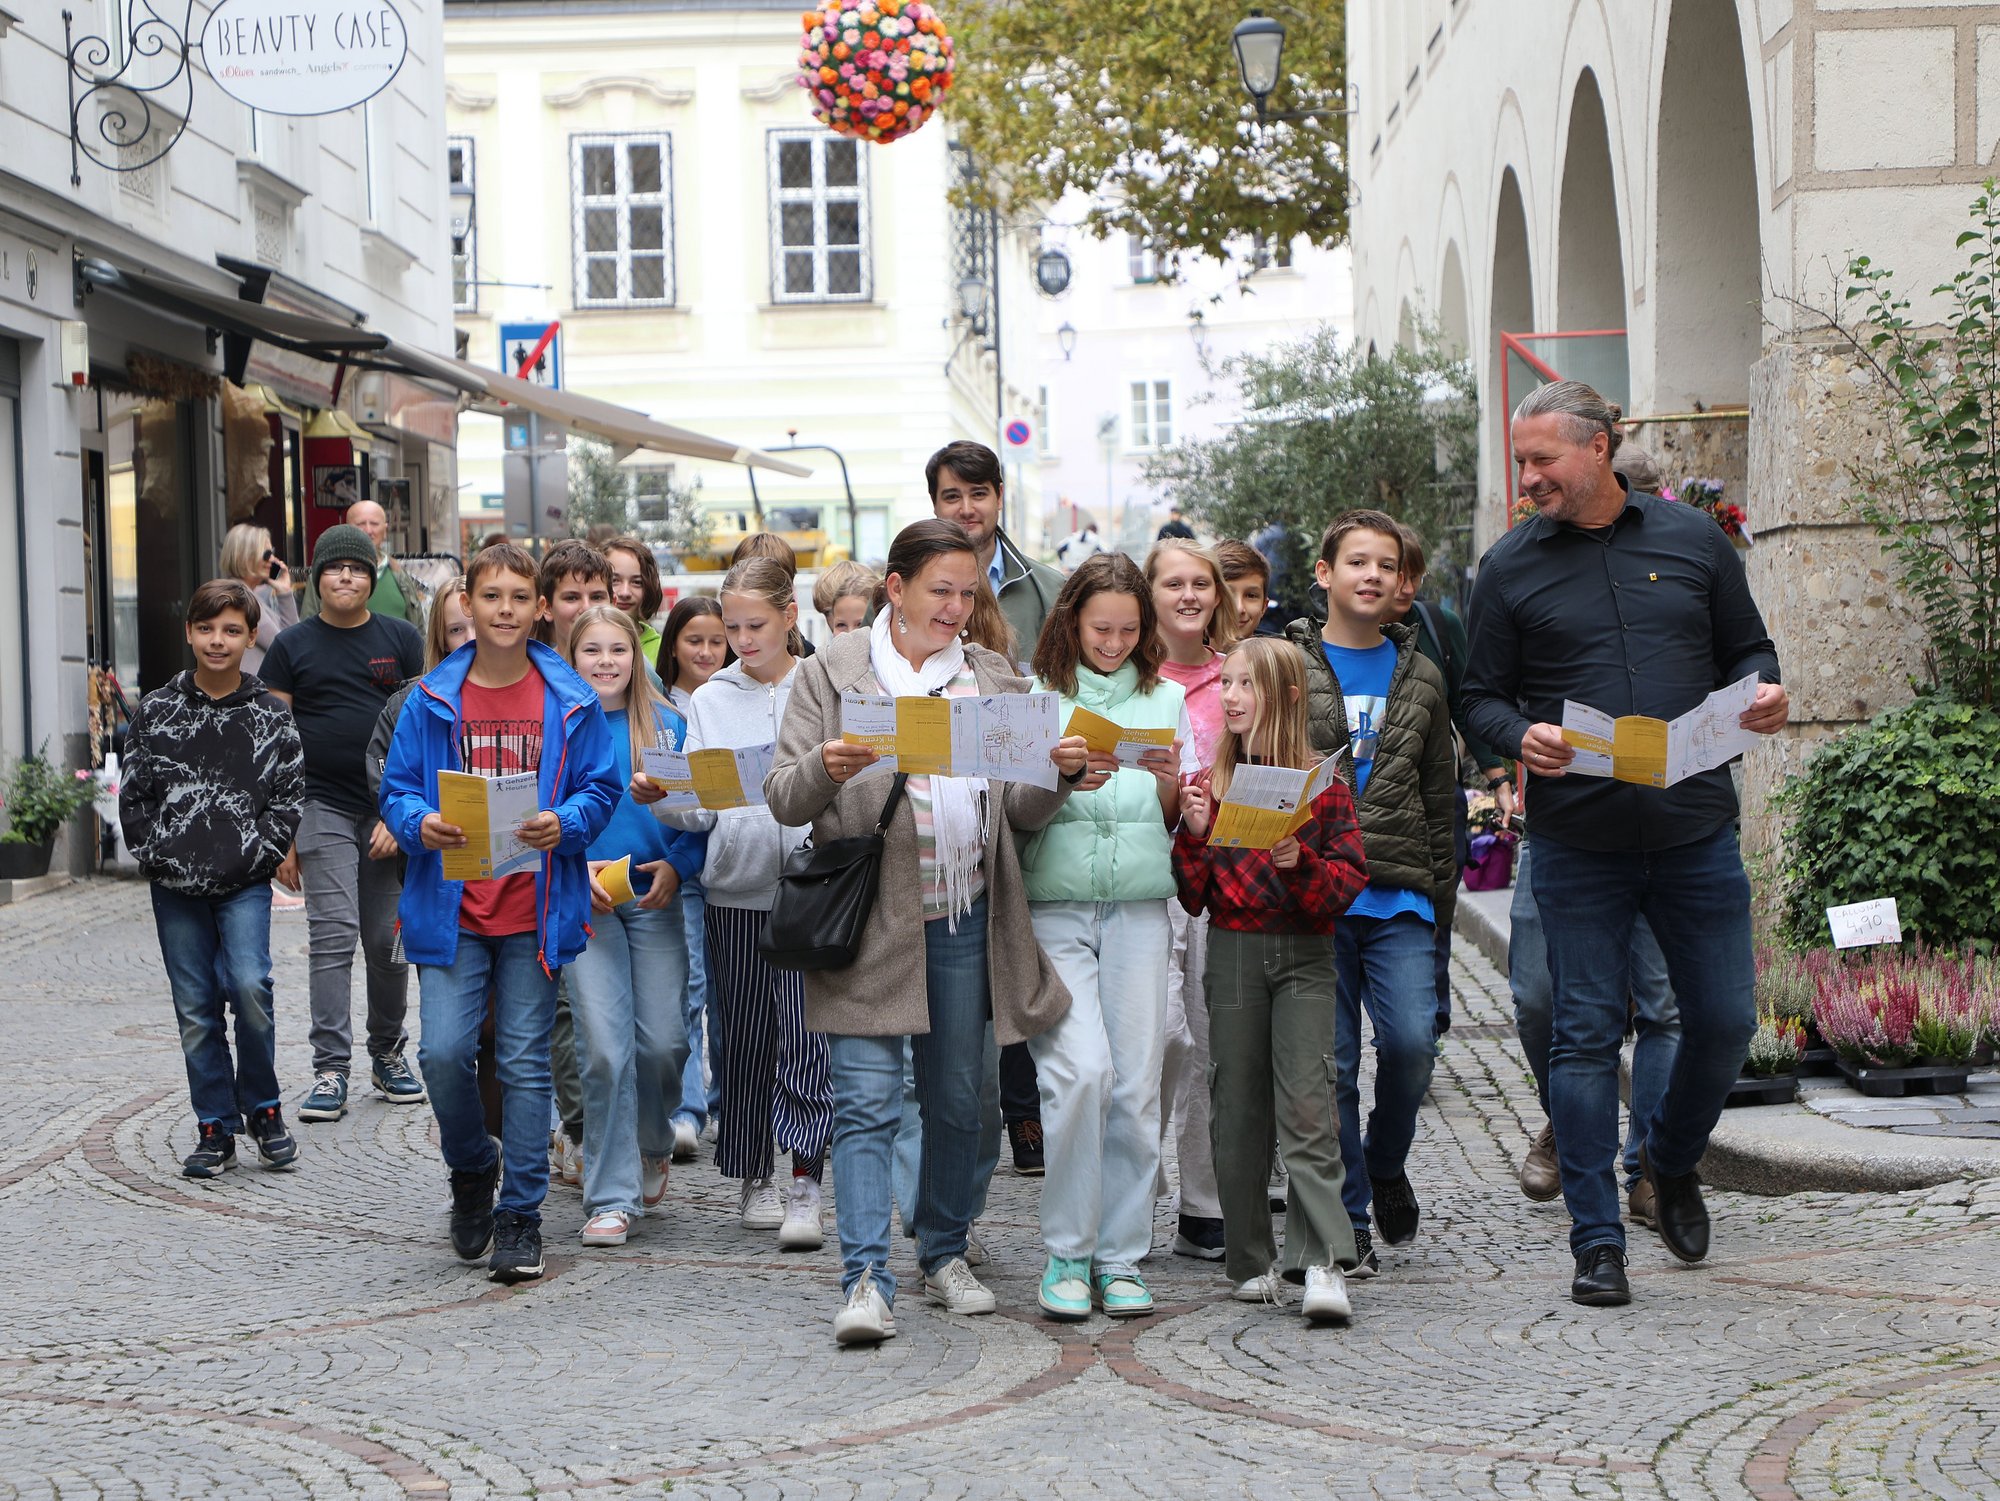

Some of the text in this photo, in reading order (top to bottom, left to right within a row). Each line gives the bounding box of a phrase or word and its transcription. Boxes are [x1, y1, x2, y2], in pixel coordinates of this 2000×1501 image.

[218, 10, 391, 56] BEAUTY CASE
[306, 61, 342, 75] Angels
[1123, 729, 1150, 737] Gehen
[1131, 736, 1157, 744] Krems
[1846, 914, 1882, 935] 4,90
